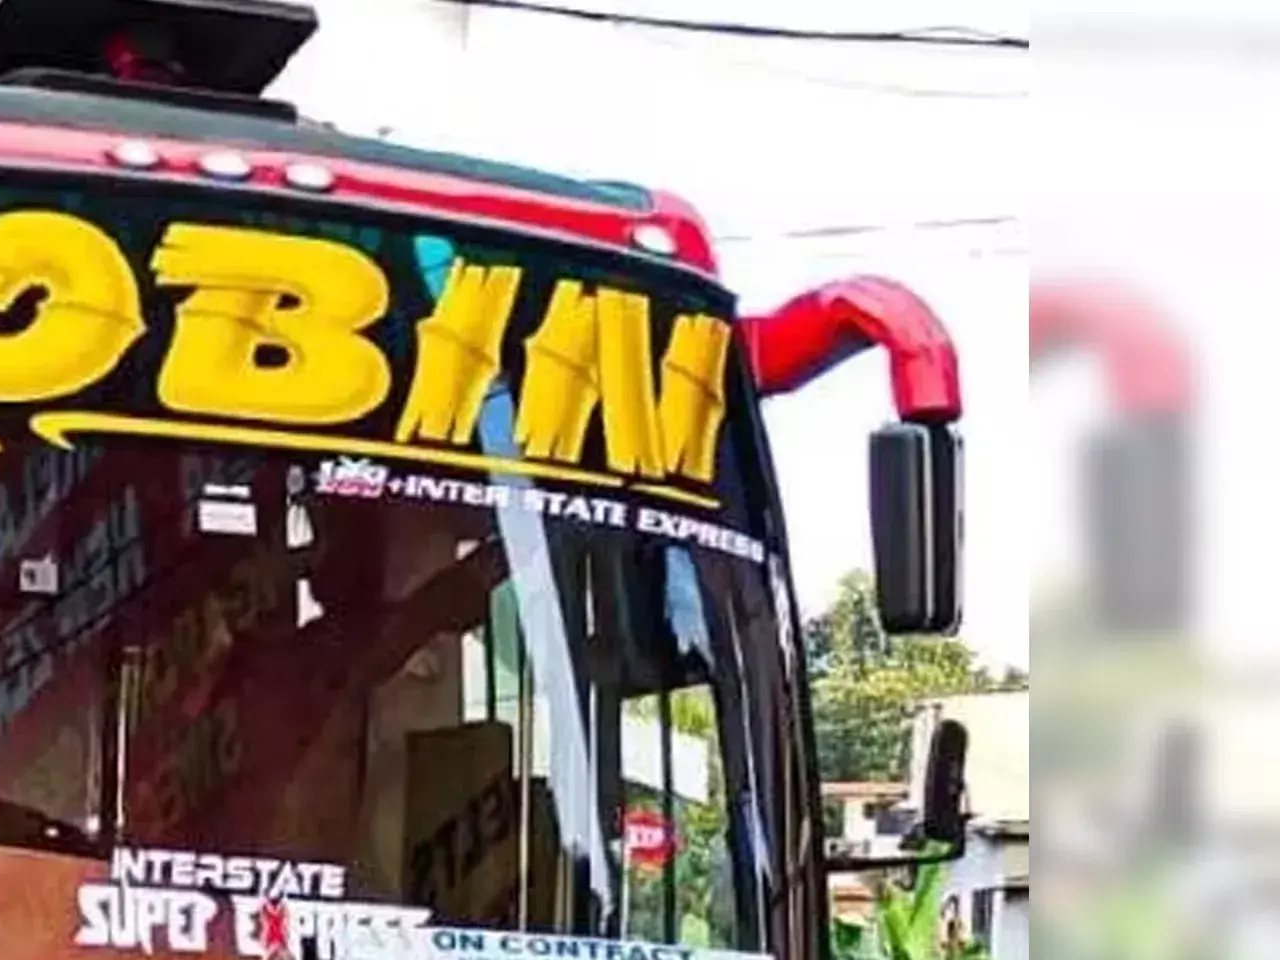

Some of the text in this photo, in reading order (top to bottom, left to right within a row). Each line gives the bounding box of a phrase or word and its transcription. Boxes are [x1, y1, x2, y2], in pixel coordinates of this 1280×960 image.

[637, 505, 765, 564] EXPRESS
[111, 846, 347, 897] INTERSTATE
[75, 884, 217, 955] SUPER
[431, 931, 486, 953] ON
